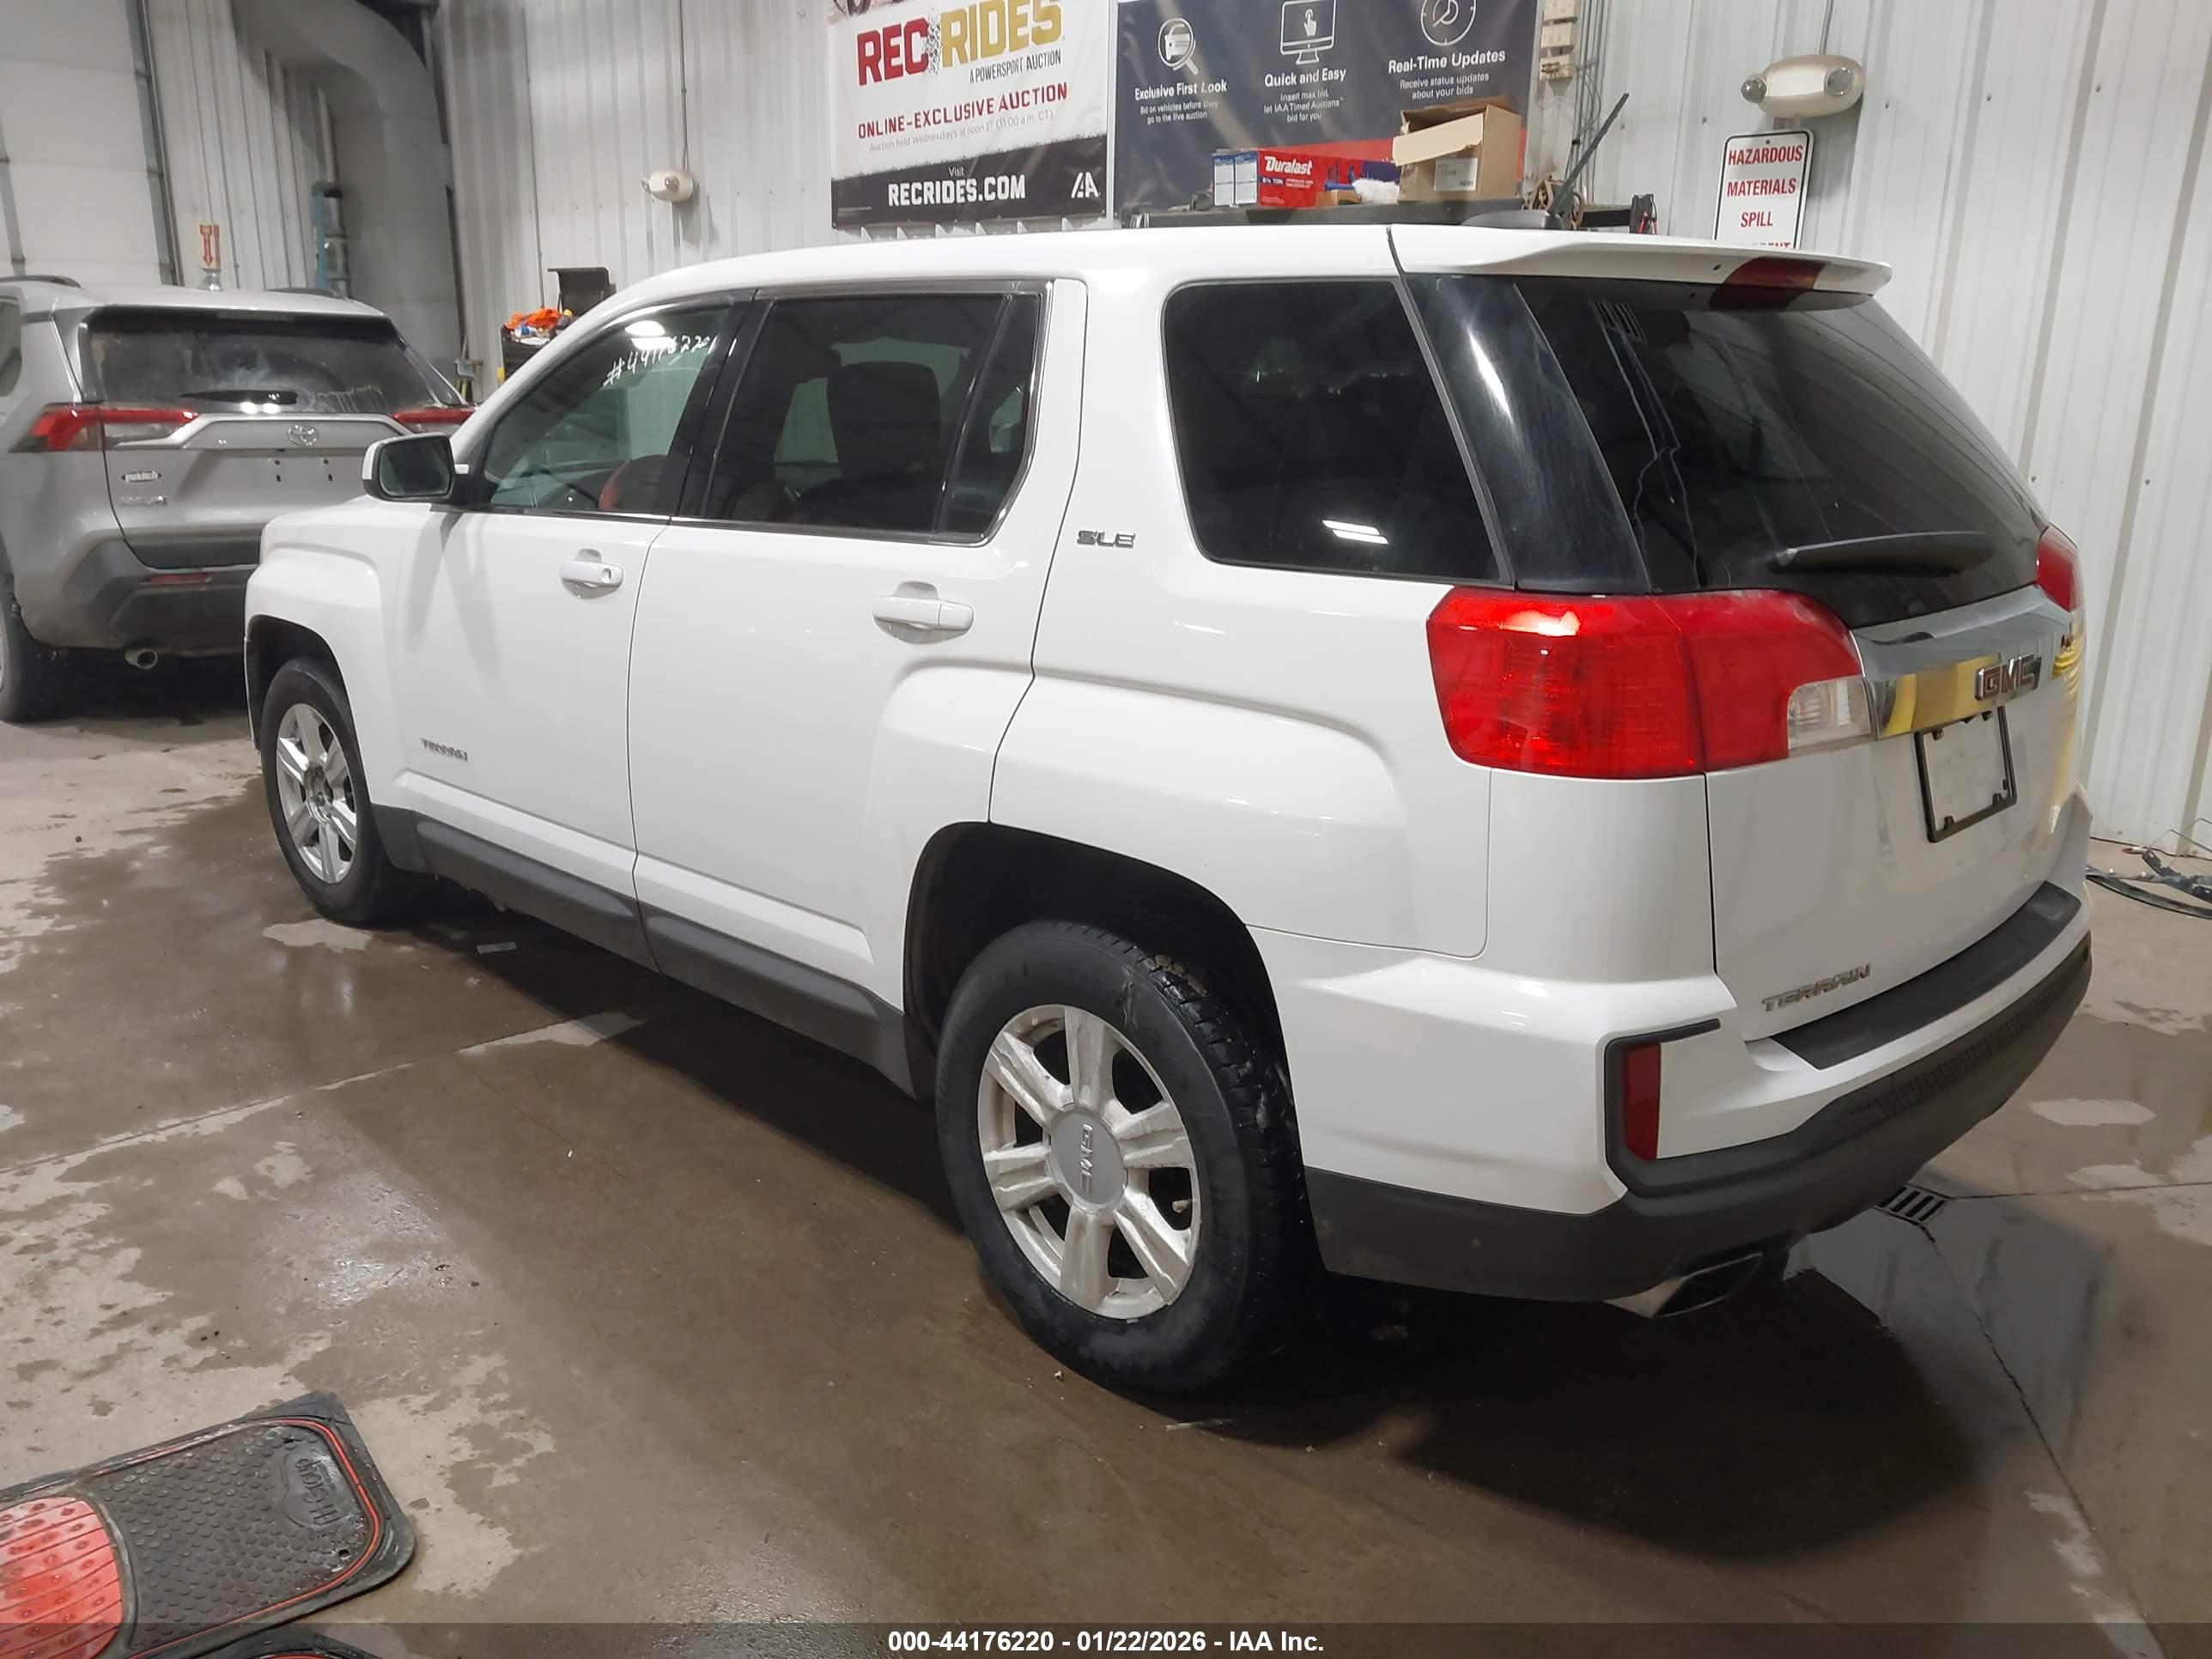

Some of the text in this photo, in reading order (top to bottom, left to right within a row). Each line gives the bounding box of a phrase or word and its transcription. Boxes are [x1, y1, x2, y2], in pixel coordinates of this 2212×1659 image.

[856, 0, 1063, 86] REC RIDES
[969, 48, 1061, 84] A POWERSPORT AUCTION
[1389, 50, 1506, 74] Real-Time Updates
[1264, 67, 1346, 88] Quick and Easy
[1400, 72, 1490, 89] Receive status updates
[1134, 78, 1227, 100] Exclusive First Look
[1280, 92, 1300, 102] Insert
[1301, 91, 1316, 100] max
[1412, 84, 1474, 100] about your bids
[858, 82, 1067, 139] ONLINE-EXCLUSIVE AUCTION
[1140, 105, 1149, 115] Bid
[1157, 102, 1182, 112] vehicles
[1183, 100, 1201, 110] before
[1146, 110, 1207, 125] go to the live auction
[1263, 104, 1273, 113] let
[1274, 103, 1289, 112] IAA
[1290, 101, 1310, 112] Timed
[1286, 112, 1322, 123] bid for you
[869, 142, 895, 152] Auction
[896, 137, 910, 148] held
[912, 128, 957, 144] Wednesdays
[968, 125, 985, 135] noon
[1264, 155, 1313, 176] Duralast
[1728, 144, 1803, 166] HAZARDOUS
[948, 166, 964, 177] Visit
[888, 174, 1026, 207] RECRIDES.COM
[1727, 177, 1797, 197] MATERIALS
[1741, 210, 1774, 228] SPILL
[1077, 530, 1135, 549] SLE
[1975, 654, 2041, 701] GMC
[1761, 963, 1870, 1012] TERRAIN
